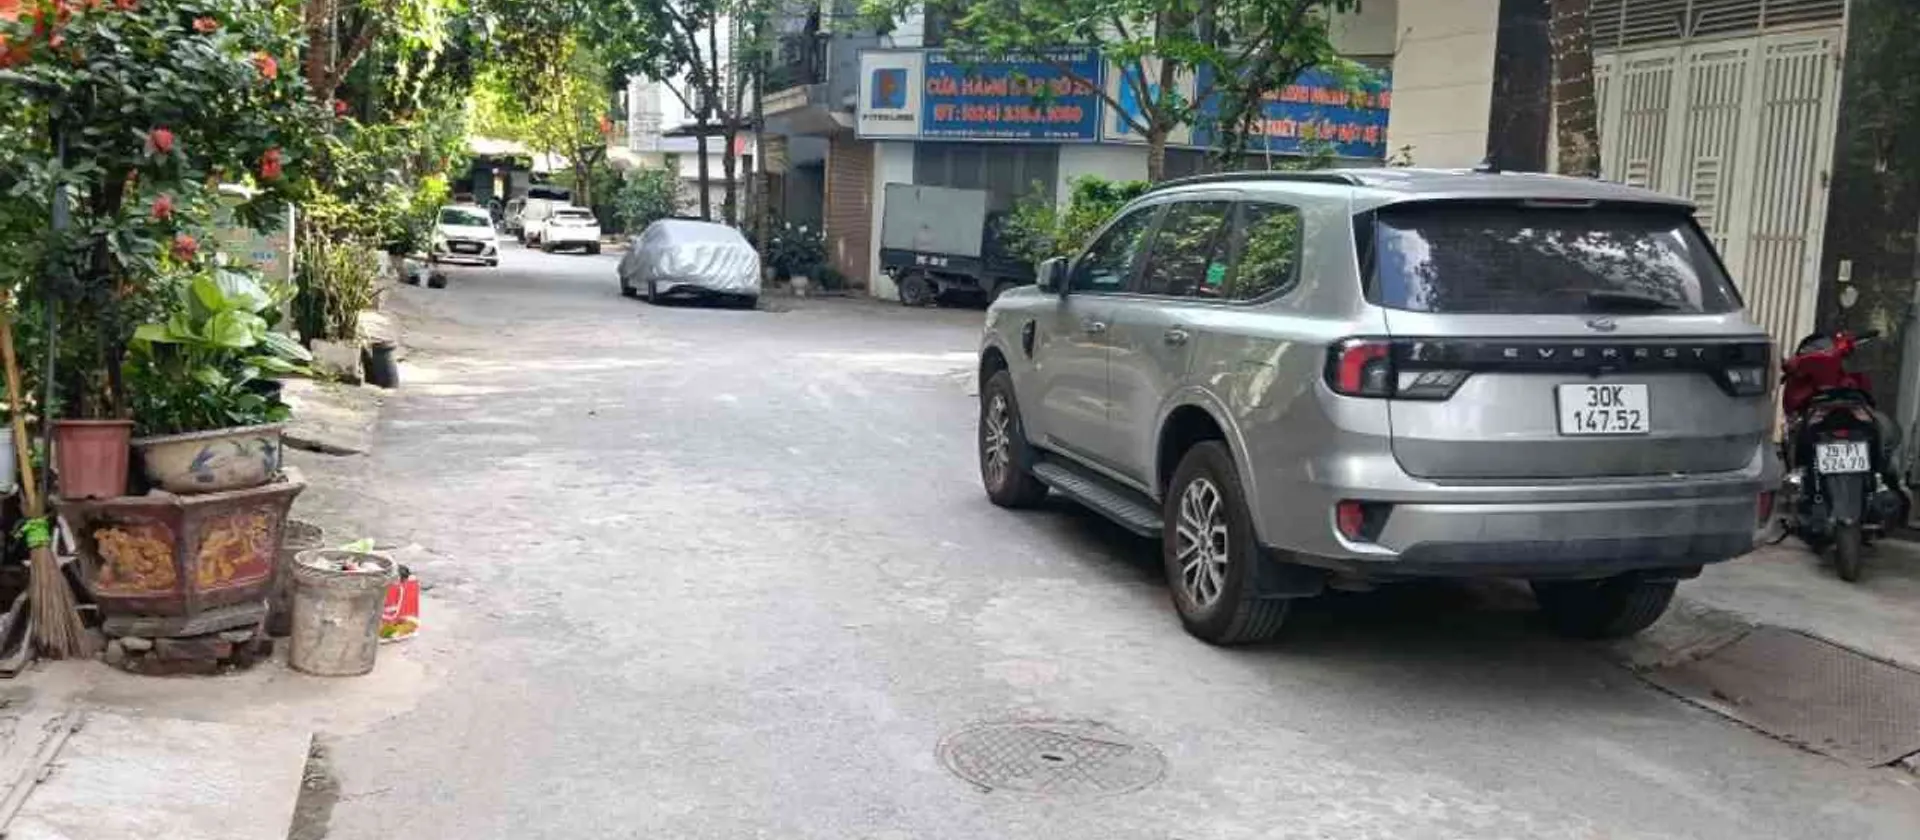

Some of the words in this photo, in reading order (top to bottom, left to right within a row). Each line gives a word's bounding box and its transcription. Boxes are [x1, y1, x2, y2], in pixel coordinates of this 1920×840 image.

[1503, 347, 1704, 358] EVEREST
[1586, 386, 1625, 408] 30K
[1574, 410, 1641, 432] 147.52
